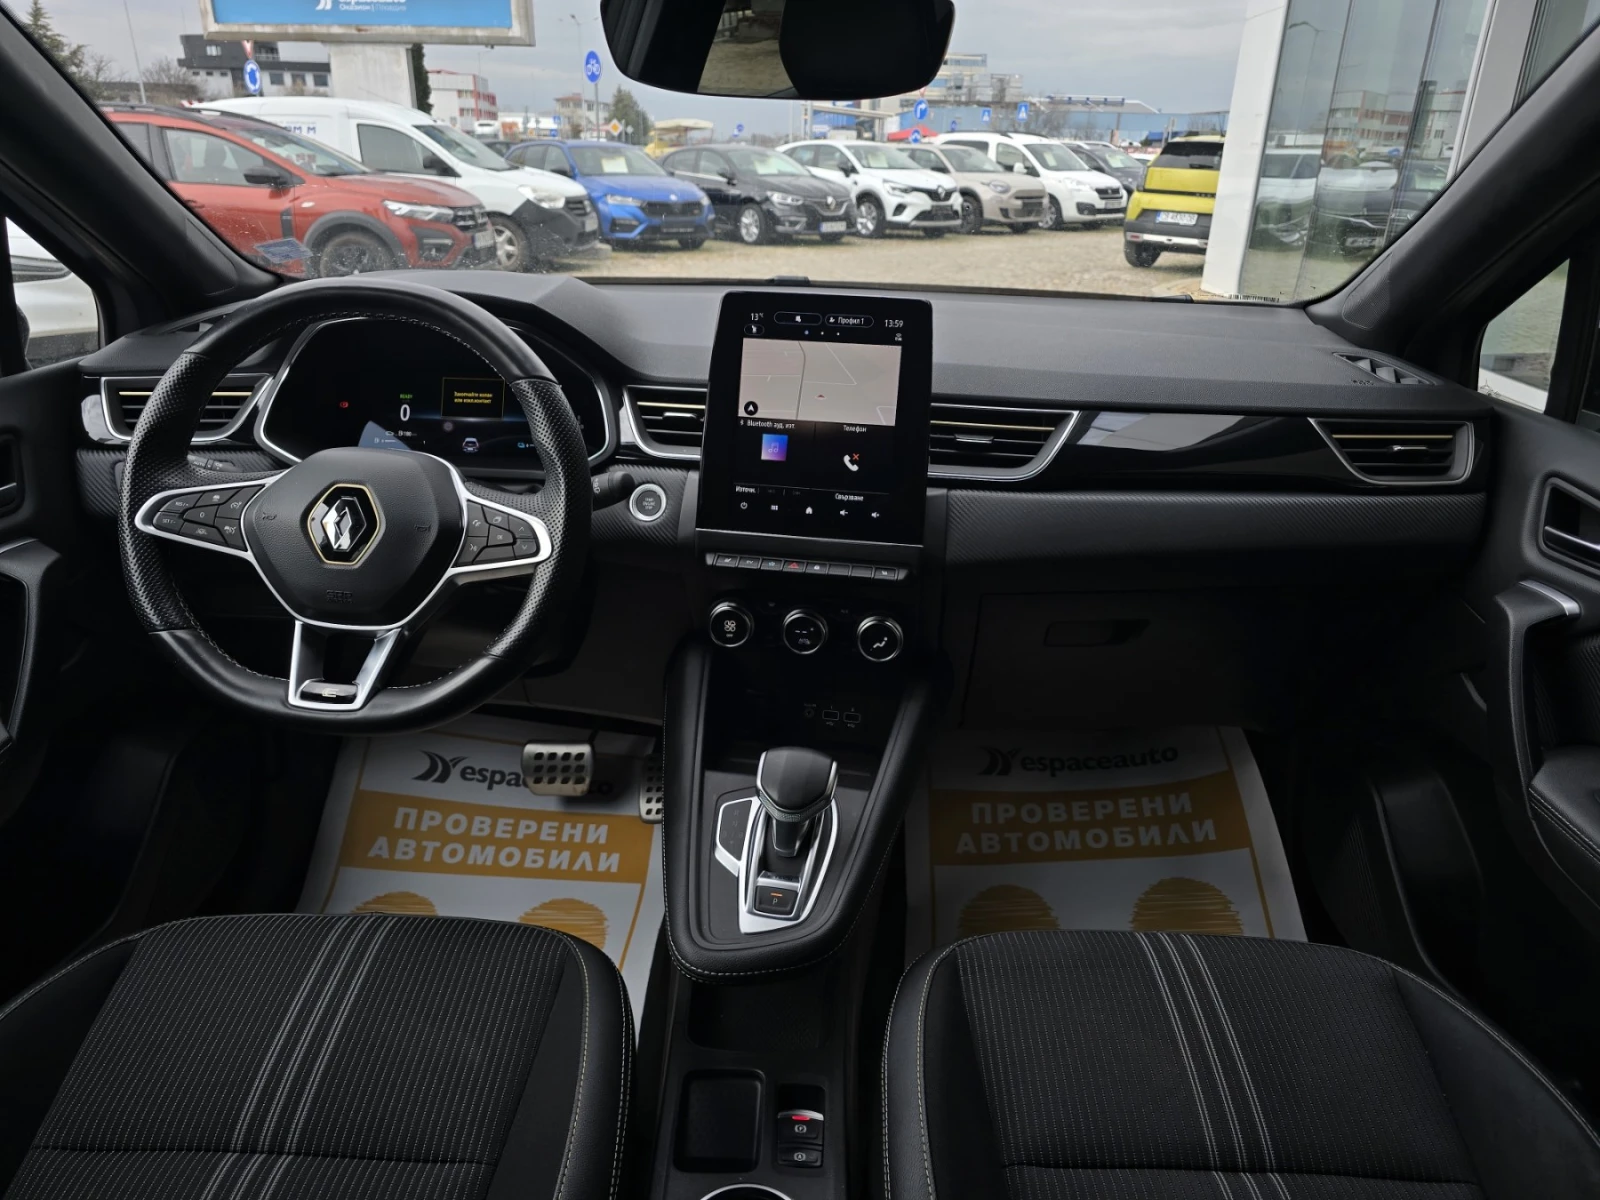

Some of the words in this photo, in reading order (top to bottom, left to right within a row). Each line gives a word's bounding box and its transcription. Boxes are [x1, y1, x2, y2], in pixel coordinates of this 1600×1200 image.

[838, 316, 860, 326] Профил
[884, 319, 904, 328] 13:59
[400, 404, 410, 422] 0
[746, 419, 772, 428] Bluetooth
[842, 424, 867, 434] Телефон
[1020, 744, 1179, 778] espaceauto
[971, 792, 1192, 825] ПРОВЕРЕНИ
[394, 806, 609, 845] ПРОВЕРЕНИ
[956, 819, 1217, 855] АВТОМОБИЛИ
[368, 836, 620, 873] АВТОМОБИЛИ
